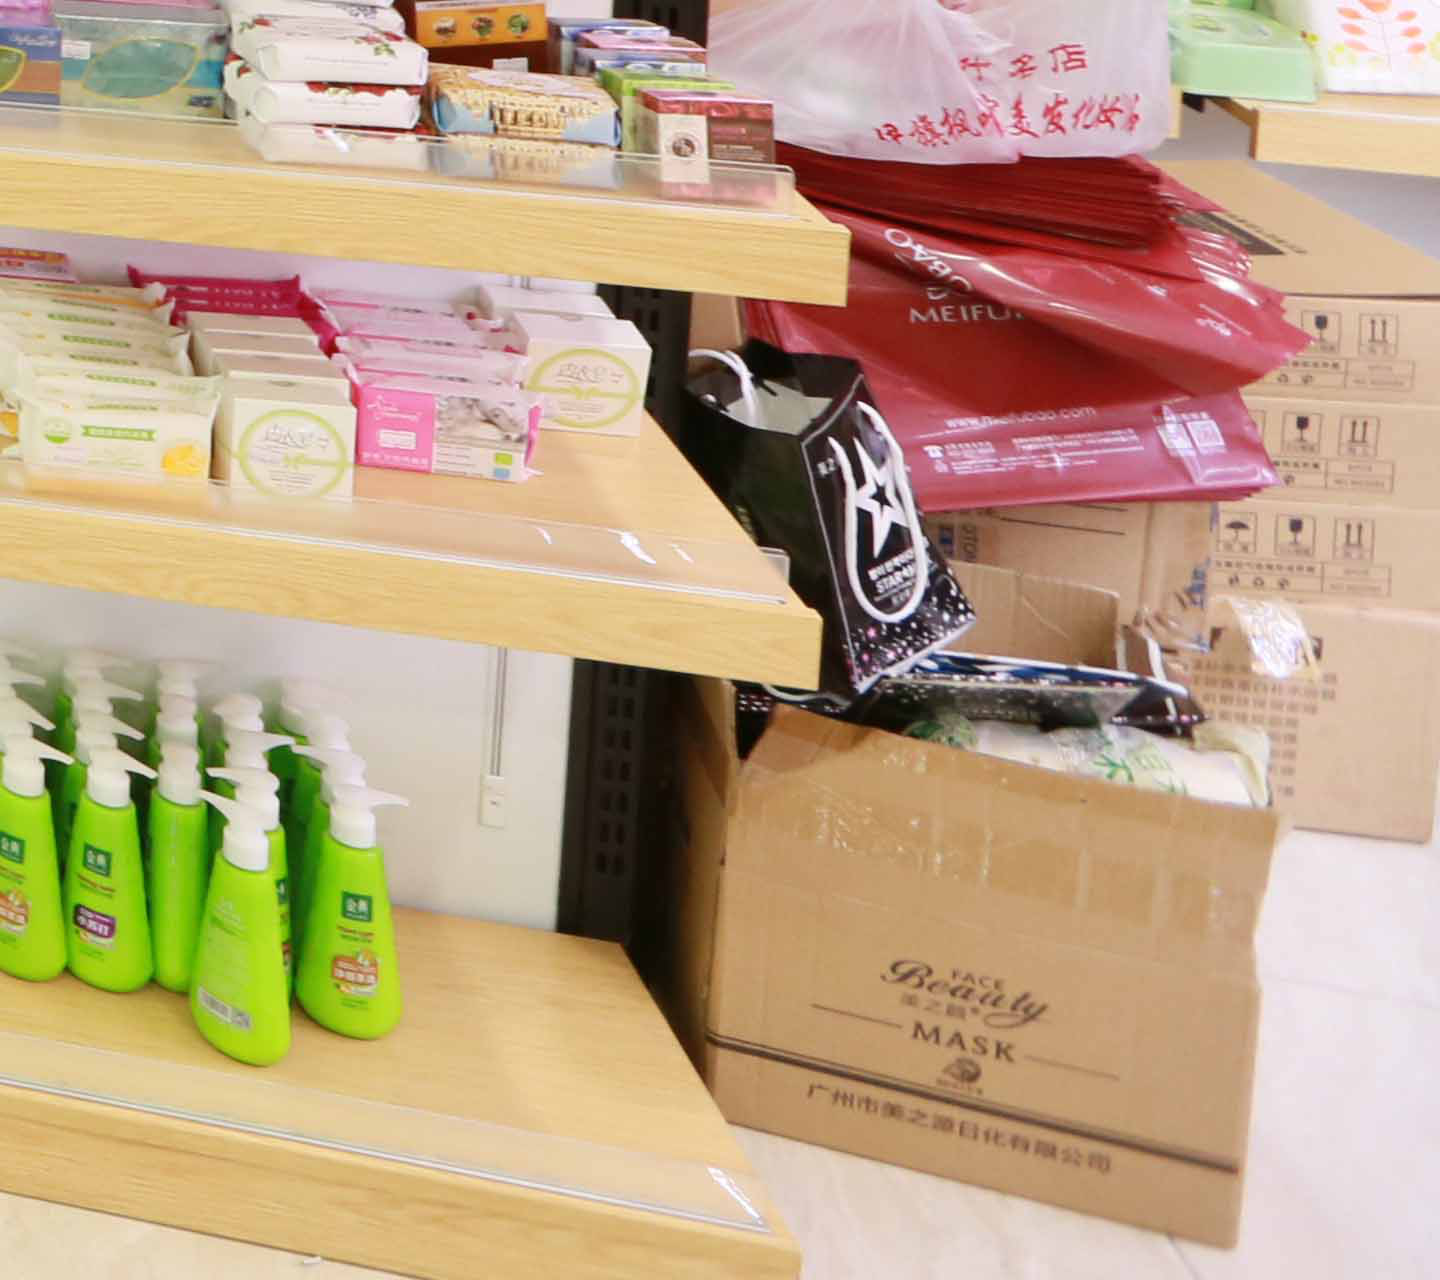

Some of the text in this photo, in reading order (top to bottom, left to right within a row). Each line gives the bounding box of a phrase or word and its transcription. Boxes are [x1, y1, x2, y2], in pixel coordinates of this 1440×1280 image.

[909, 304, 1024, 323] MEIFU
[880, 959, 1048, 1030] Beauty
[951, 968, 1005, 991] FACE
[911, 1021, 1016, 1063] MASK
